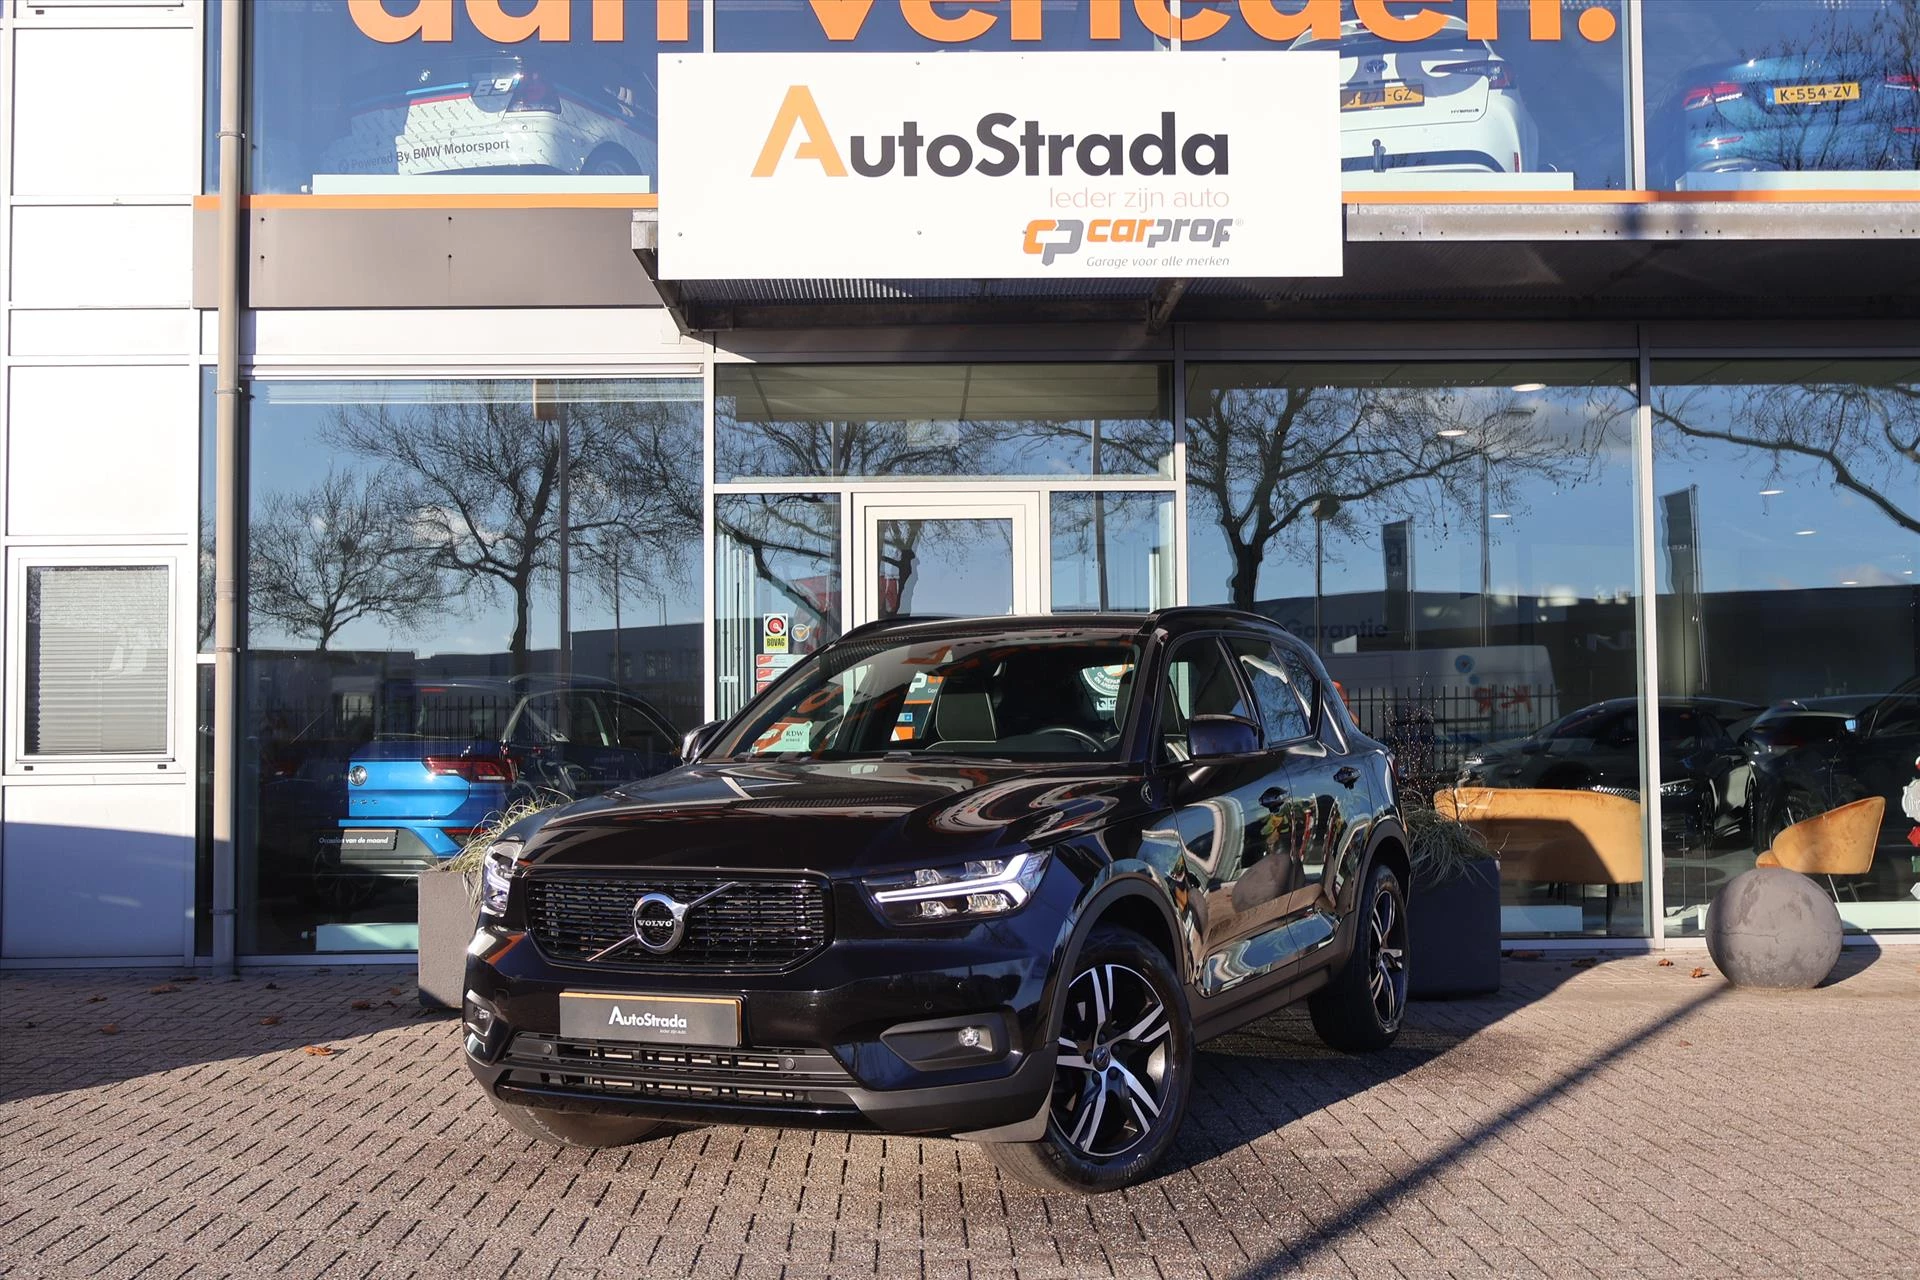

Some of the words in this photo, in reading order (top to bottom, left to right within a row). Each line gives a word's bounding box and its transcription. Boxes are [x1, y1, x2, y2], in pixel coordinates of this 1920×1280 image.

[1780, 85, 1852, 102] K-554-ZV
[750, 85, 1229, 178] AutoStrada
[396, 149, 410, 164] By
[413, 145, 441, 160] BMW
[444, 138, 510, 156] Motorsport
[1050, 187, 1116, 208] Ieder
[1124, 188, 1164, 213] zijn
[1173, 188, 1230, 208] auto
[1086, 256, 1129, 270] Garage
[1132, 259, 1158, 267] voor
[1161, 255, 1183, 267] alle
[1186, 256, 1230, 267] merken
[766, 637, 786, 647] BOVAG
[637, 919, 673, 927] VOLVO
[609, 1006, 687, 1028] AutoStrada
